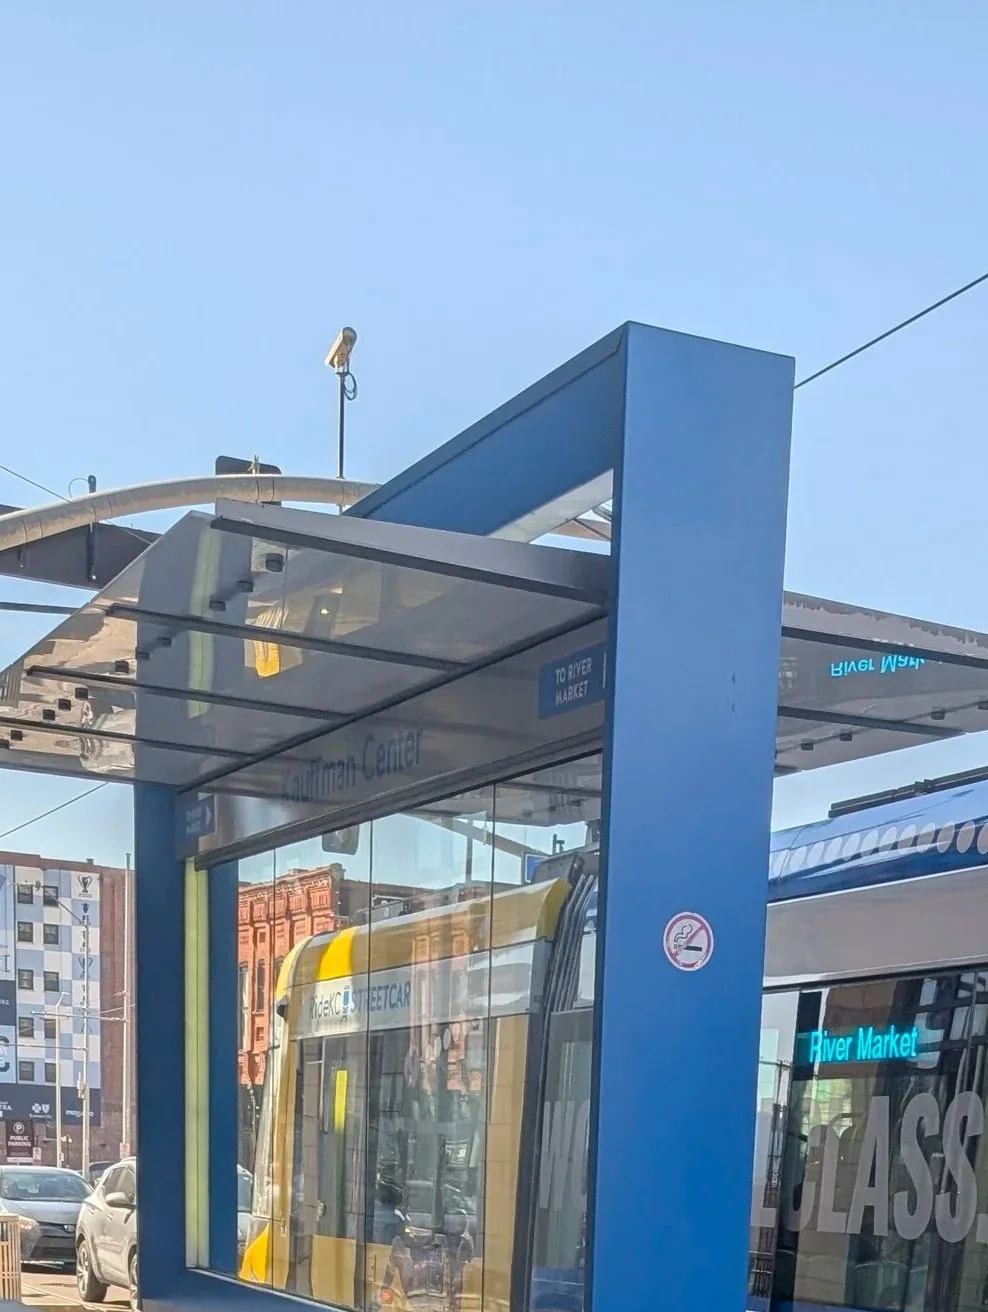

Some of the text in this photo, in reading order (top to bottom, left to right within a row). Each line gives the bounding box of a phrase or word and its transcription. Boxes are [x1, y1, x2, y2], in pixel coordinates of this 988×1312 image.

[555, 657, 592, 685] TO RIVER
[555, 680, 589, 707] MARKET
[362, 730, 423, 781] Center
[309, 981, 411, 1019] RideKC STREETCAR
[809, 1024, 918, 1063] River Market
